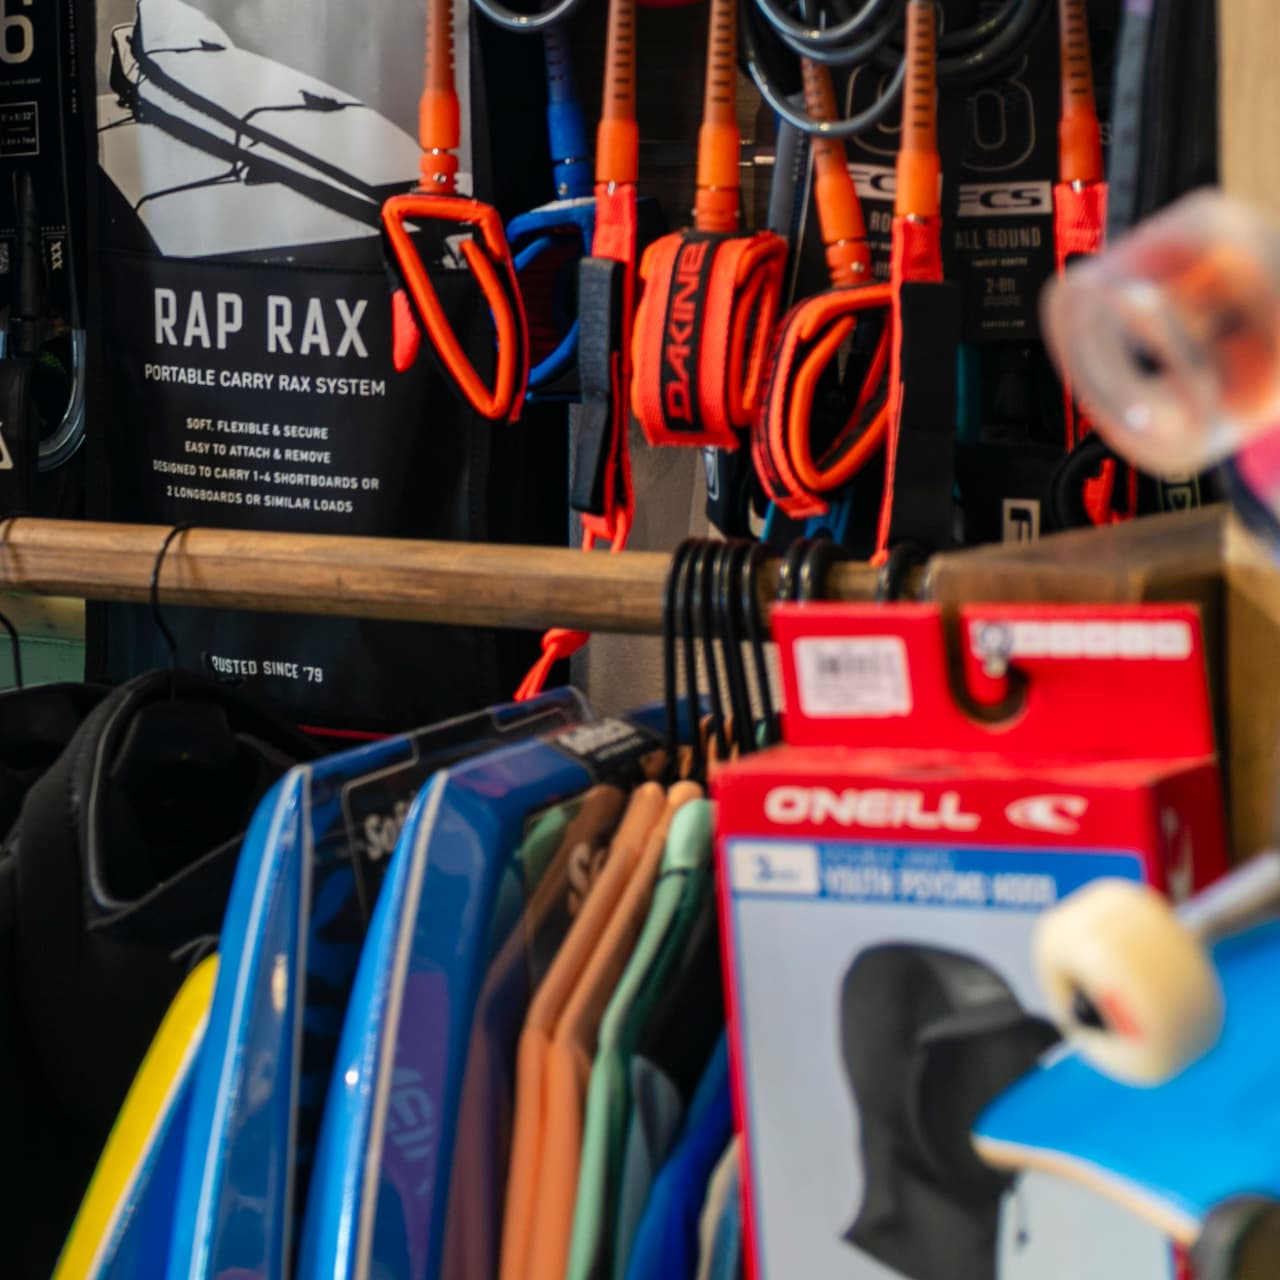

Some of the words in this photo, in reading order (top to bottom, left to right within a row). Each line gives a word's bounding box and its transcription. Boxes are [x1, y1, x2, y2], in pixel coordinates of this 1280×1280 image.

[955, 229, 982, 249] ALL
[986, 227, 1042, 249] ROUND
[154, 287, 243, 351] RAP
[266, 294, 369, 358] RAX
[665, 240, 710, 423] DAKINE
[145, 363, 216, 387] PORTABLE
[219, 370, 275, 391] CARRY
[278, 375, 312, 393] RAX
[315, 377, 386, 396] SYSTEM
[217, 420, 270, 437] FLEXIBLE
[283, 425, 329, 440] SECURE
[184, 440, 210, 455] EASY
[212, 443, 227, 456] TO
[229, 445, 271, 460] ATTACH
[284, 449, 331, 465] REMOVE
[153, 459, 197, 477] DESIGNED
[198, 464, 212, 478] TO
[214, 466, 250, 482] CARRY
[253, 470, 272, 483] 1-4
[274, 472, 359, 490] SHORTBOARDS
[361, 478, 380, 490] OR
[174, 486, 243, 504] LONGBOARDS
[245, 493, 261, 506] OR
[263, 495, 311, 510] SIMILAR
[313, 499, 353, 514] LOADS
[212, 656, 258, 676] RUSTED
[262, 661, 298, 679] SINCE
[302, 666, 324, 684] '79
